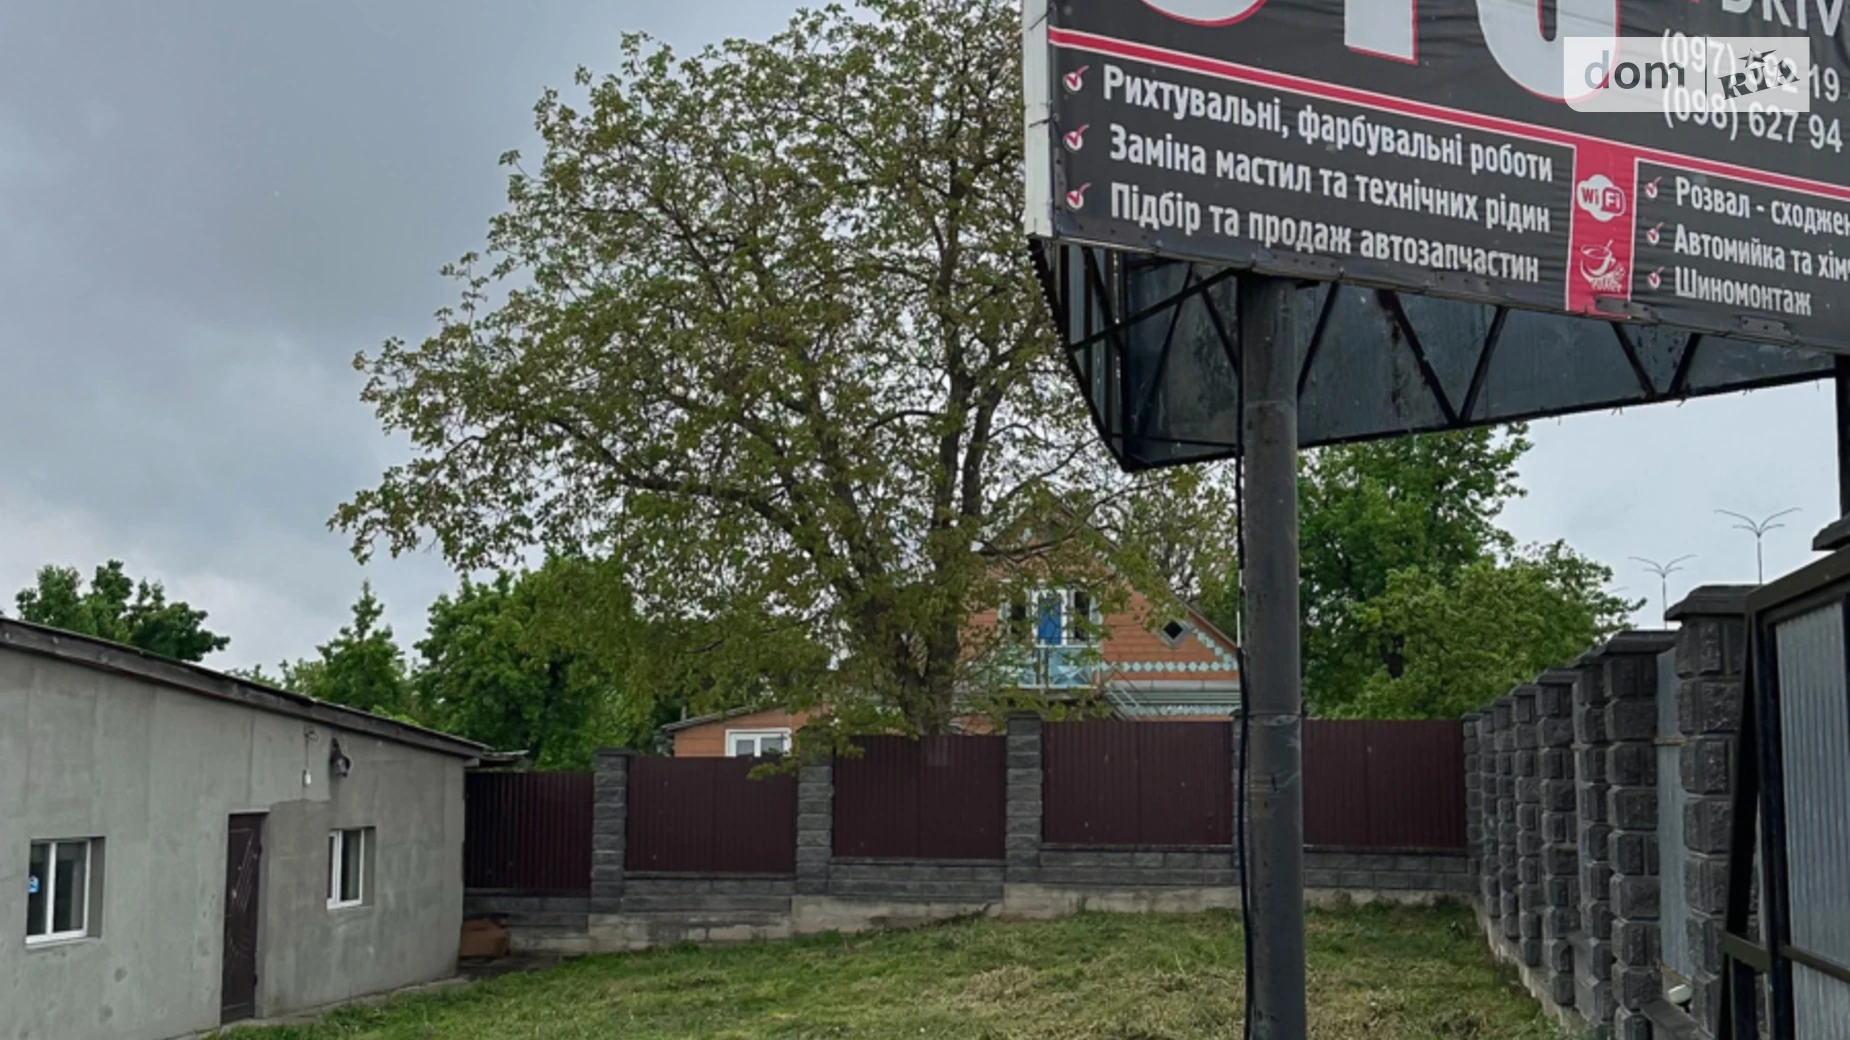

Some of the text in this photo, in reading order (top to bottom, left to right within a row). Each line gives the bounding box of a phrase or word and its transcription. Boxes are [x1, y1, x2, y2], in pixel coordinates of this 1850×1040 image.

[1661, 28, 1736, 89] (097)
[1809, 64, 1840, 102] 19
[1103, 64, 1553, 182] Рихтувальні, фарбувальні роботи
[1662, 82, 1843, 153] (098) 627 94
[1109, 123, 1550, 234] Заміна мастил та технічних рідин
[1675, 176, 1750, 219] Розвал
[1111, 182, 1200, 236] Підбір
[1209, 204, 1240, 237] та
[1249, 211, 1352, 254] продаж
[1360, 229, 1539, 283] автозапчастин
[1674, 224, 1785, 271] Автомийка
[1790, 249, 1812, 276] та
[1675, 266, 1812, 317] Шиномонтаж
